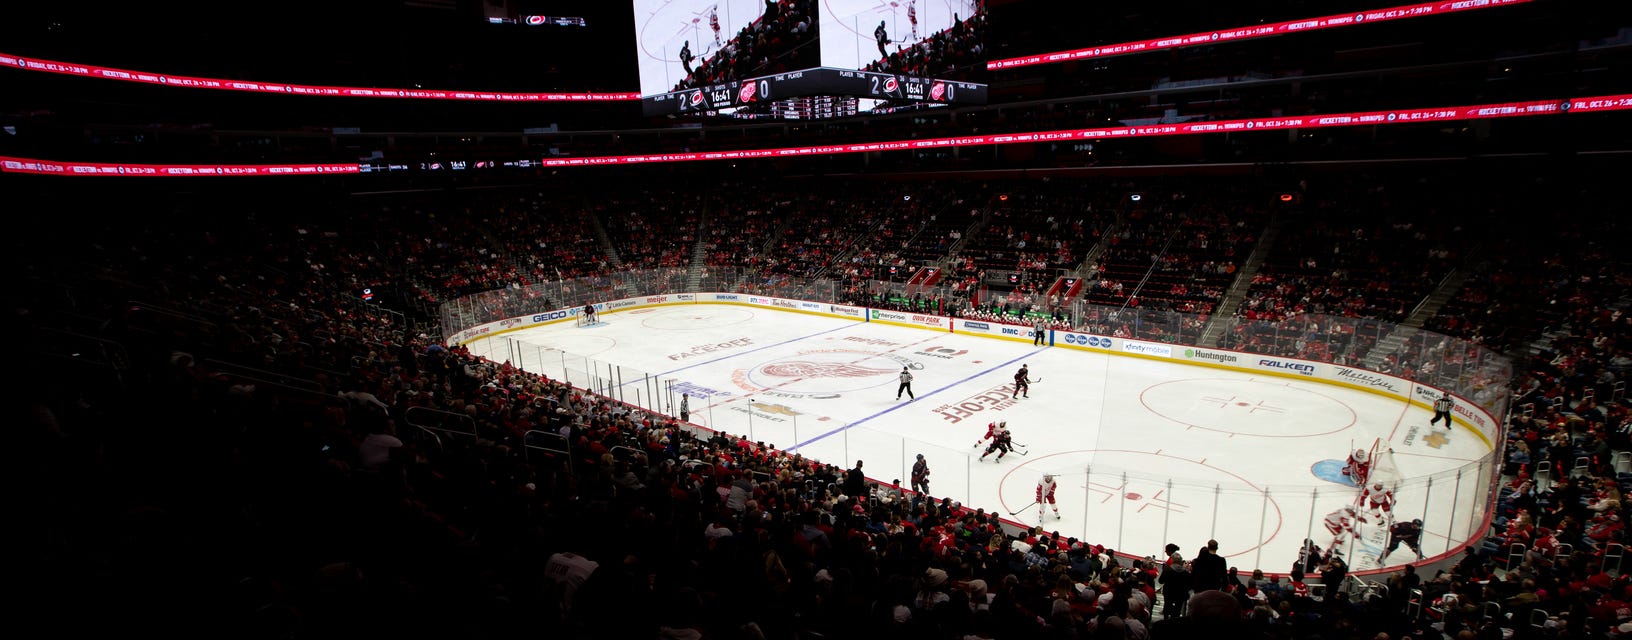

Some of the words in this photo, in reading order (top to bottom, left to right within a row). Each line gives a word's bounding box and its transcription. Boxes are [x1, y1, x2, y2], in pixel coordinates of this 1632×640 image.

[788, 72, 802, 80] PLAYER
[760, 80, 768, 99] 0
[872, 76, 879, 95] 2
[906, 82, 923, 94] 16:41
[947, 84, 954, 100] 0
[679, 93, 687, 111] 2
[711, 89, 730, 102] 16:41
[647, 295, 668, 304] meijer
[533, 311, 567, 323] GEICO
[912, 314, 925, 322] QWIK
[926, 316, 941, 324] PARK
[1002, 328, 1018, 336] DMC
[667, 336, 754, 361] FACE-OFF
[1125, 341, 1146, 352] xfinity
[1146, 344, 1170, 355] mobile
[1195, 350, 1237, 362] Huntington
[1259, 359, 1315, 372] FALKEN
[1453, 404, 1474, 419] BELLE
[1473, 415, 1486, 427] TIRE
